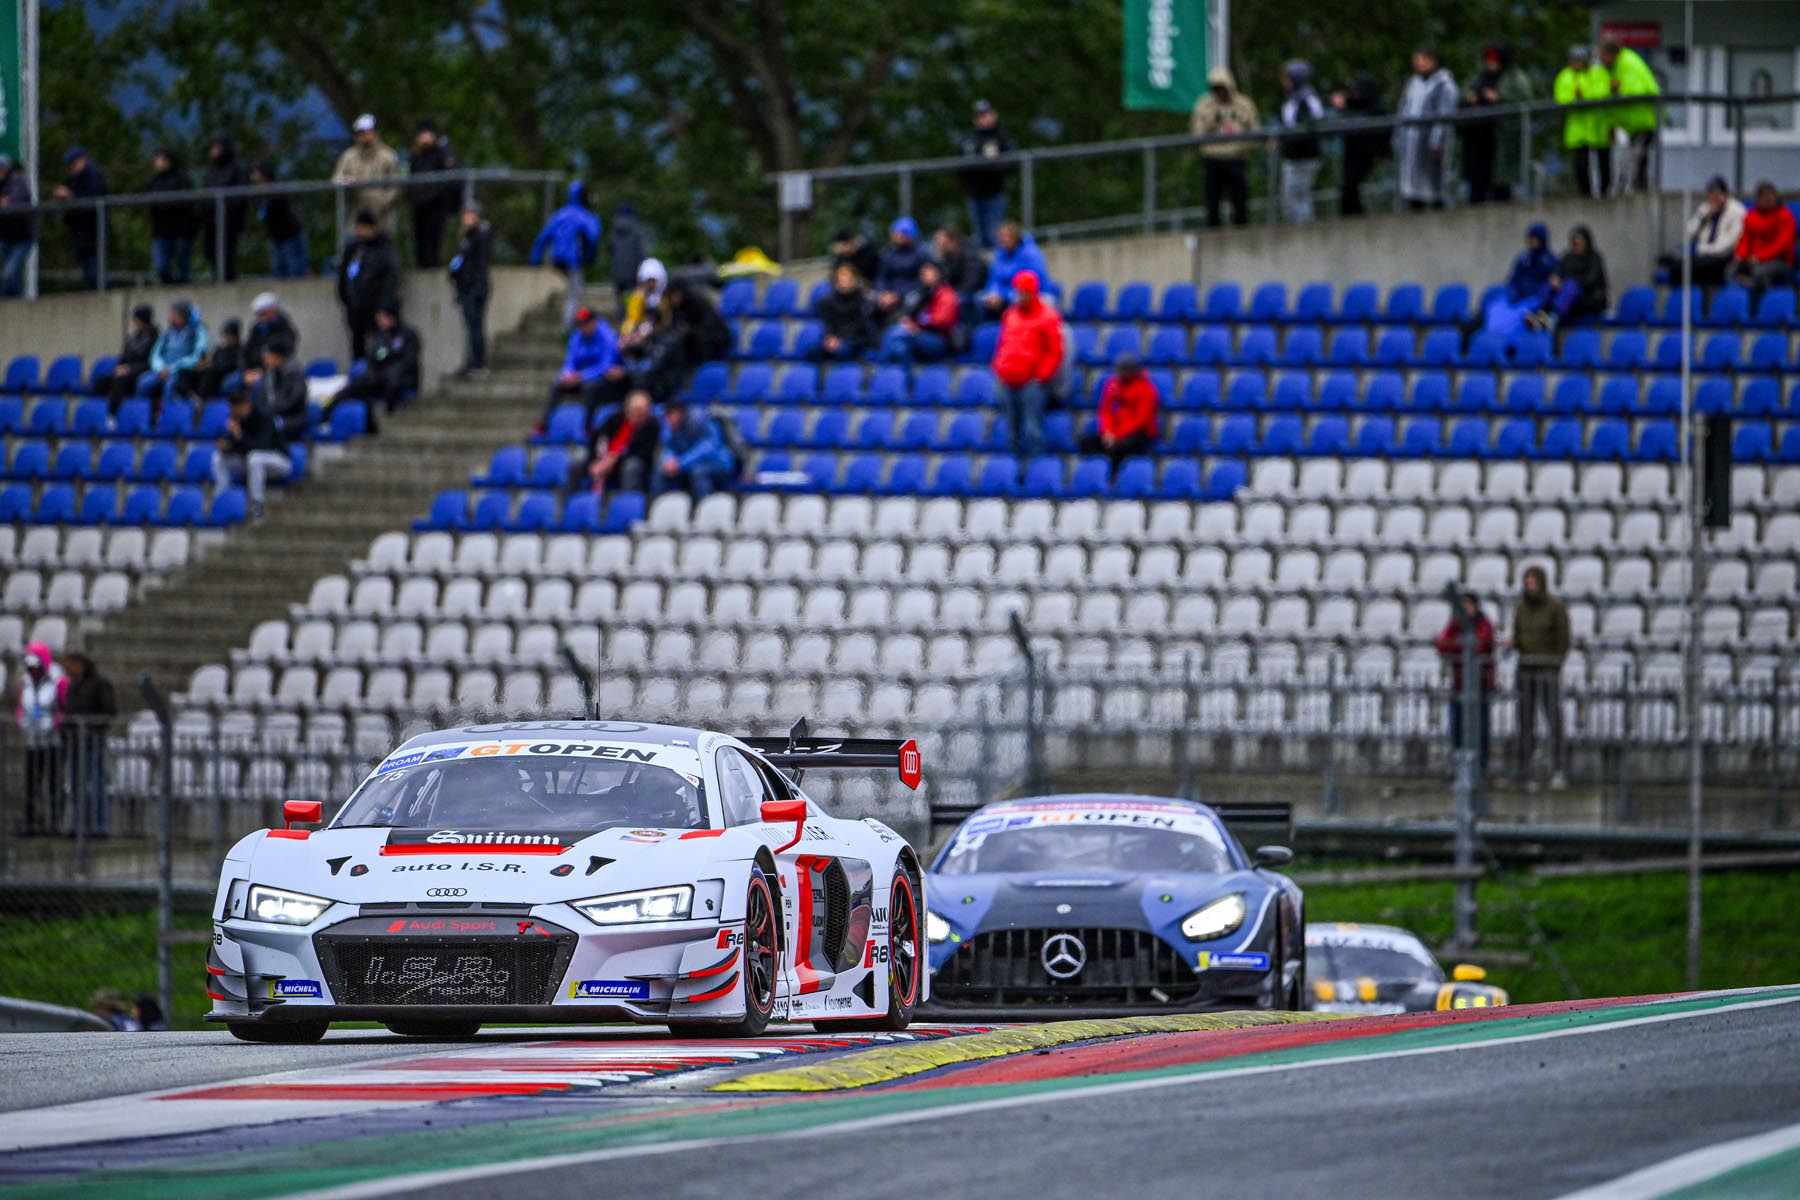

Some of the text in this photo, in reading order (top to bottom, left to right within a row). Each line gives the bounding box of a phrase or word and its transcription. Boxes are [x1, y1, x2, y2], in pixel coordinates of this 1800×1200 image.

[381, 756, 423, 770] PROAM
[391, 862, 527, 874] auto I.S.R.
[408, 921, 496, 932] Audi Sport
[871, 946, 888, 964] R8
[364, 956, 510, 985] I.S.R.
[588, 985, 641, 995] MICHELIN
